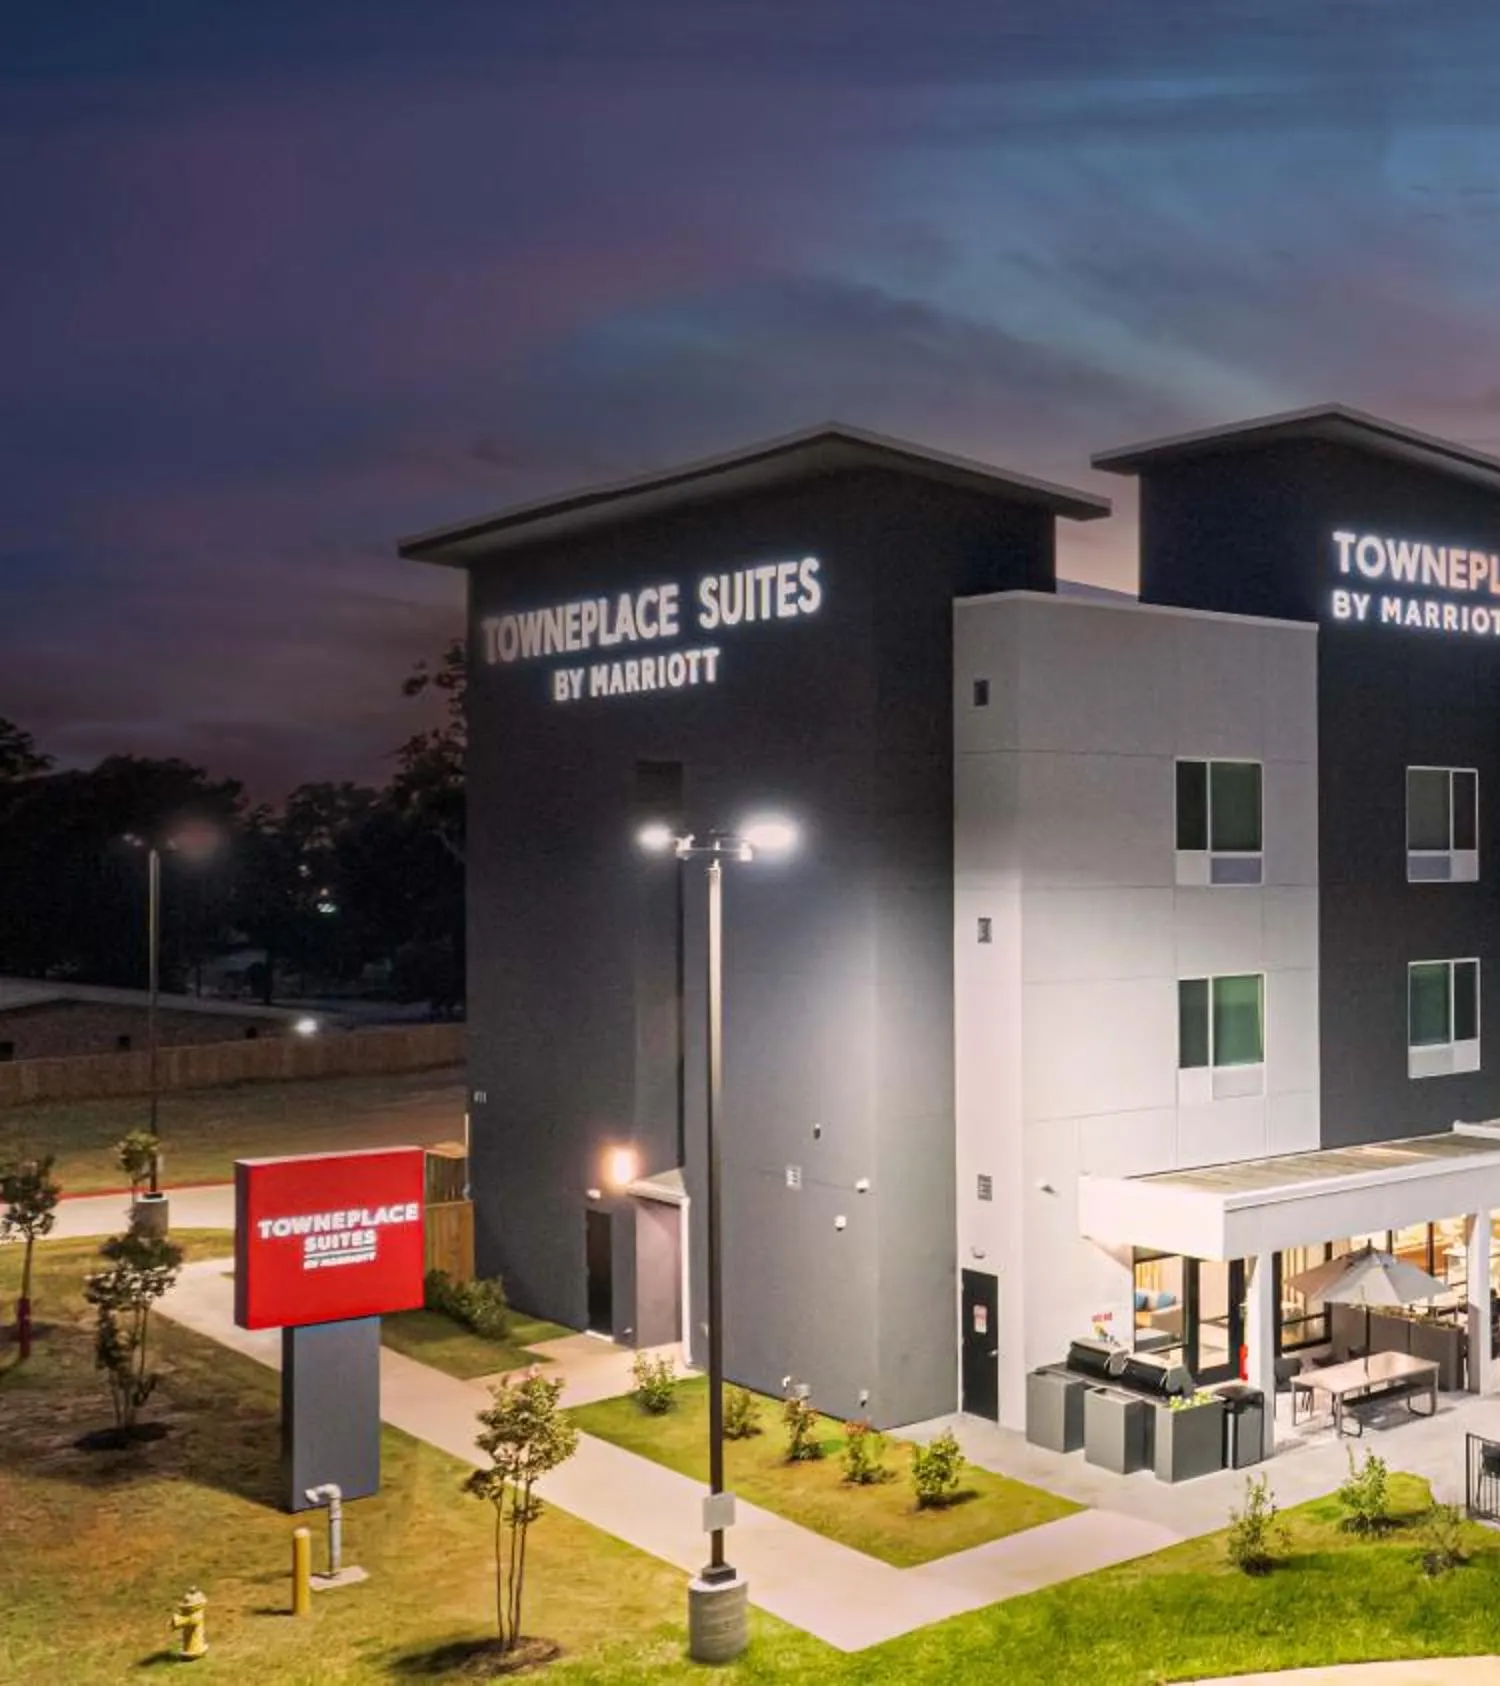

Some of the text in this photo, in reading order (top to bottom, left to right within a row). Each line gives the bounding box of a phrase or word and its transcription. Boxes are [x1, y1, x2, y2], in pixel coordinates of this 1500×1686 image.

[482, 557, 821, 665] TOWNEPLACE SUITES
[1333, 590, 1370, 620] BY
[554, 648, 720, 701] BY MARRIOTT
[258, 1203, 419, 1238] TOWNEPLACE
[304, 1229, 376, 1252] SUITES
